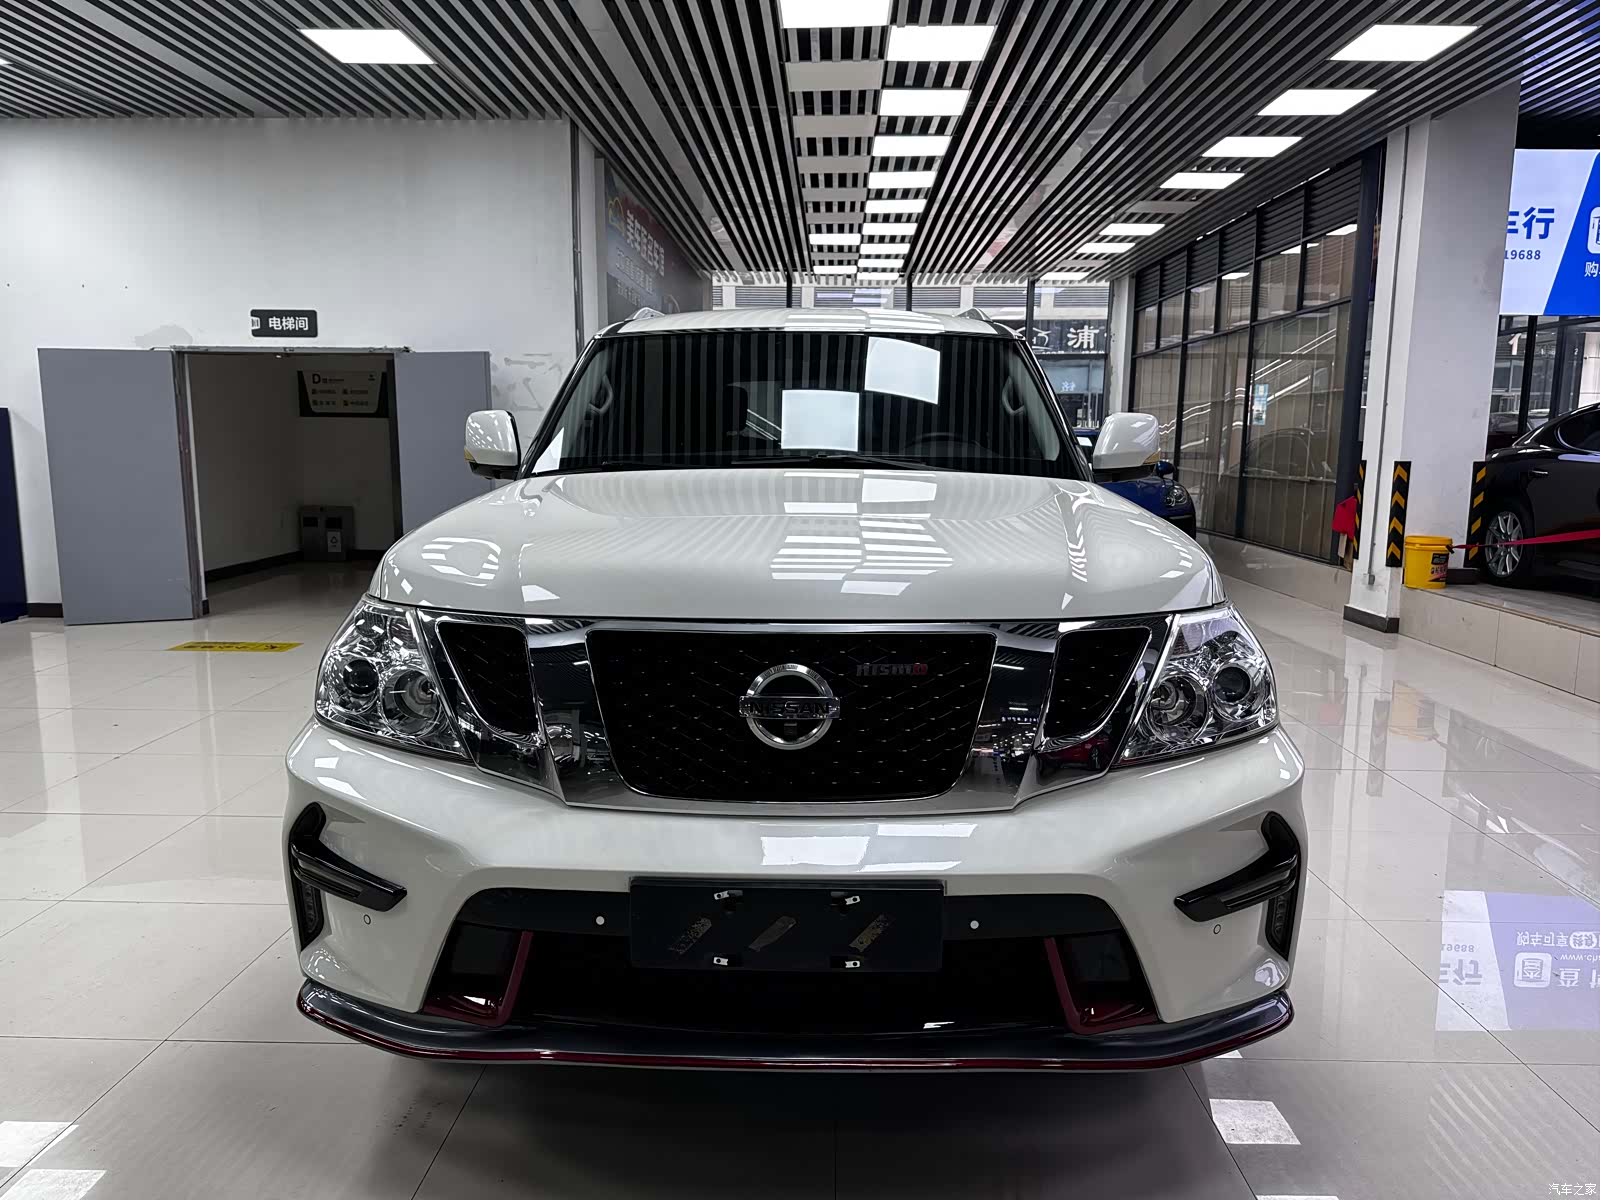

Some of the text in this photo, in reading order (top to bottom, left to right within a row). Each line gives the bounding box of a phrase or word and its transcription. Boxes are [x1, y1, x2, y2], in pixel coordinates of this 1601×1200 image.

[1584, 261, 1600, 277] 购
[268, 316, 309, 331] 电梯间
[1067, 325, 1099, 349] 浦
[312, 373, 321, 384] D
[749, 701, 830, 715] NISSAN
